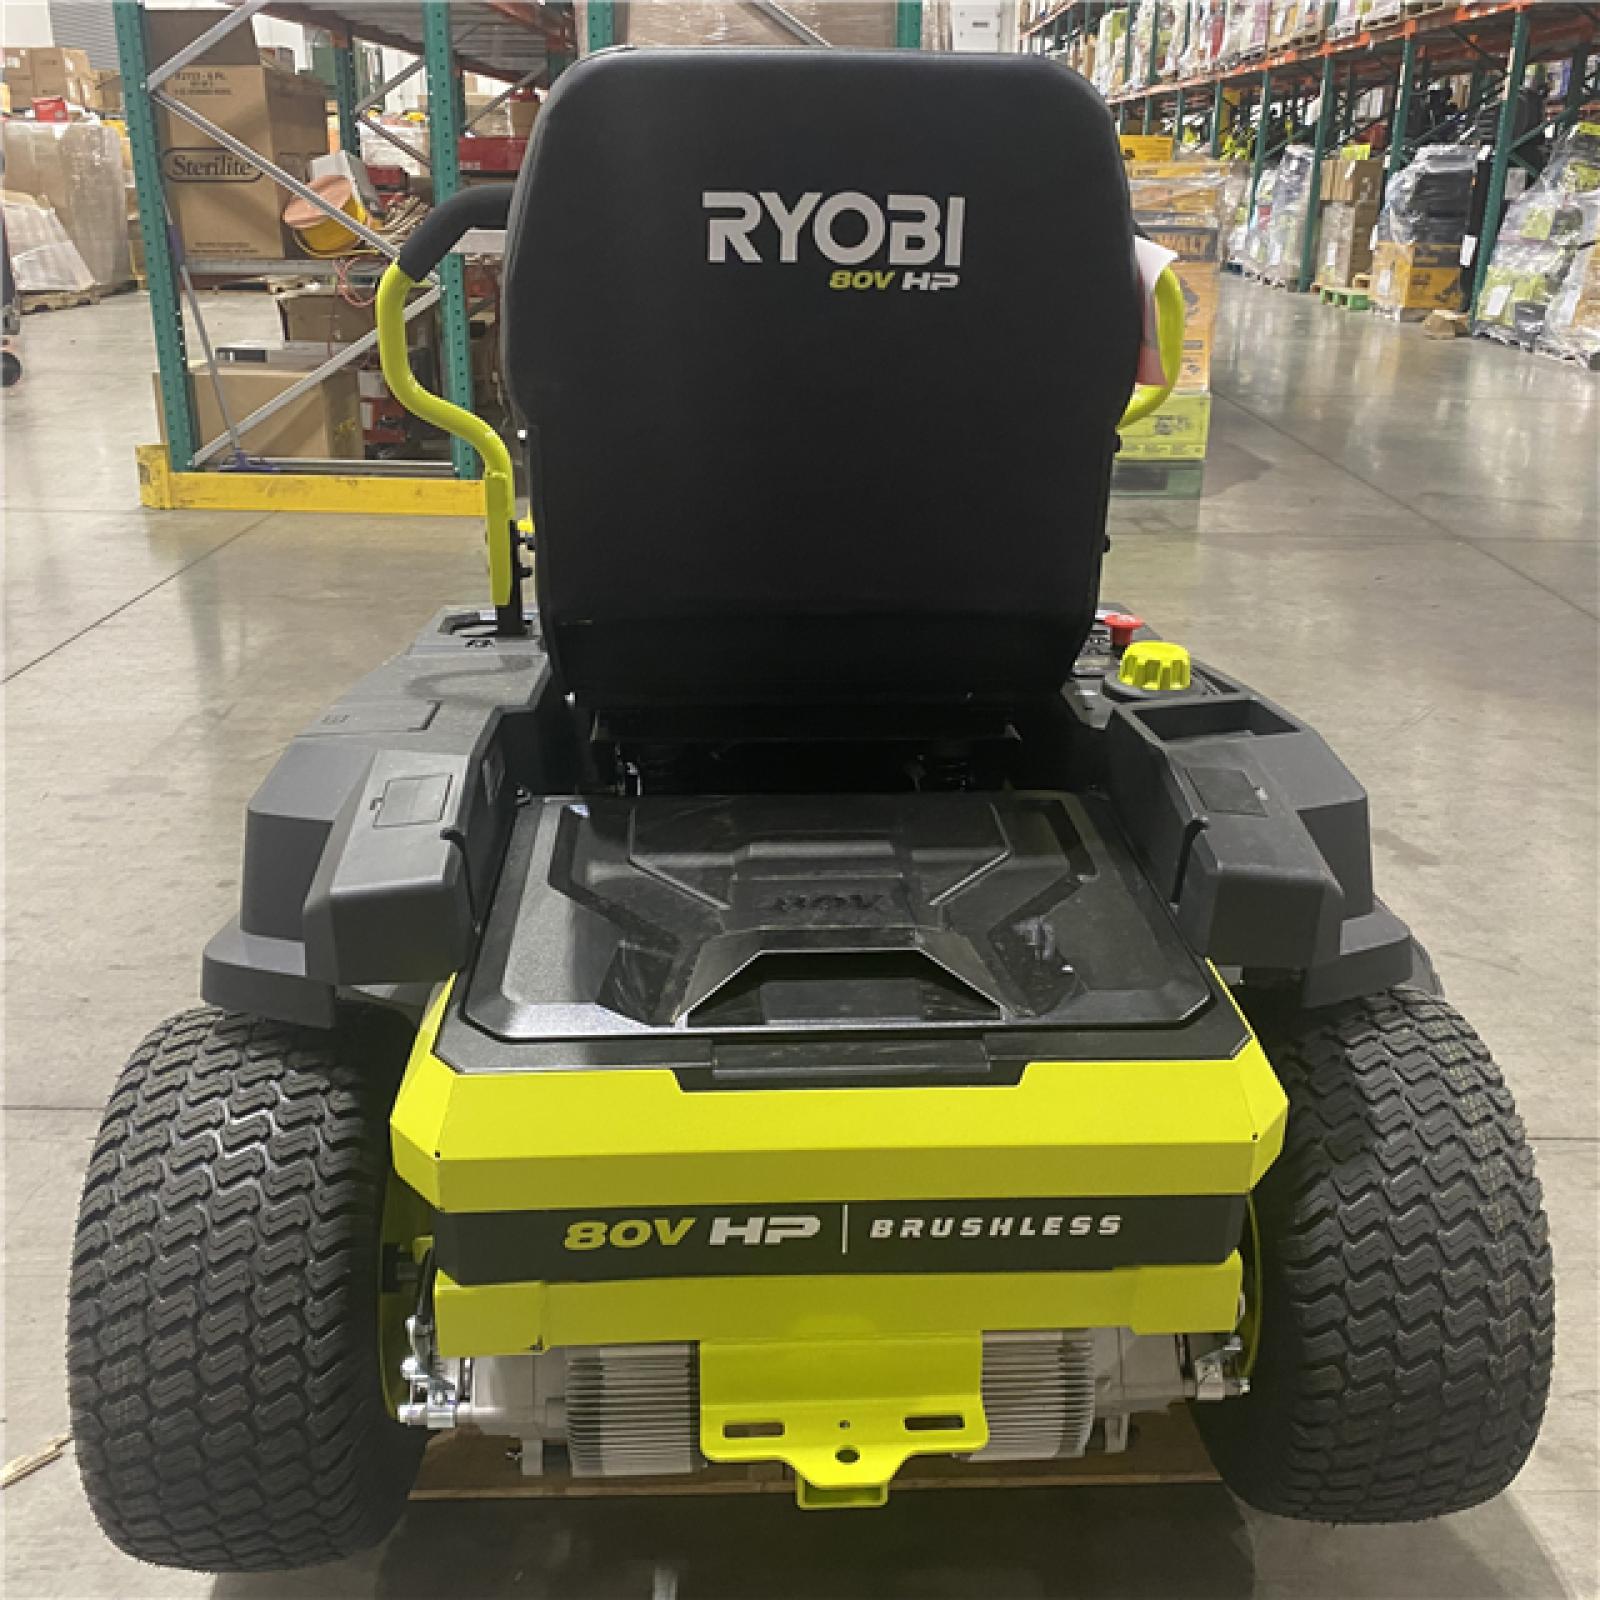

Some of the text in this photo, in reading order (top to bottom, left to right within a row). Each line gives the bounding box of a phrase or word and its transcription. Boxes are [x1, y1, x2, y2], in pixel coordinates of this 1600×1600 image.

[172, 154, 252, 176] Sterilite
[703, 191, 965, 266] RYOBI
[830, 272, 960, 291] 80V HP
[564, 1214, 1123, 1250] 80V HP BRUSHLESS
